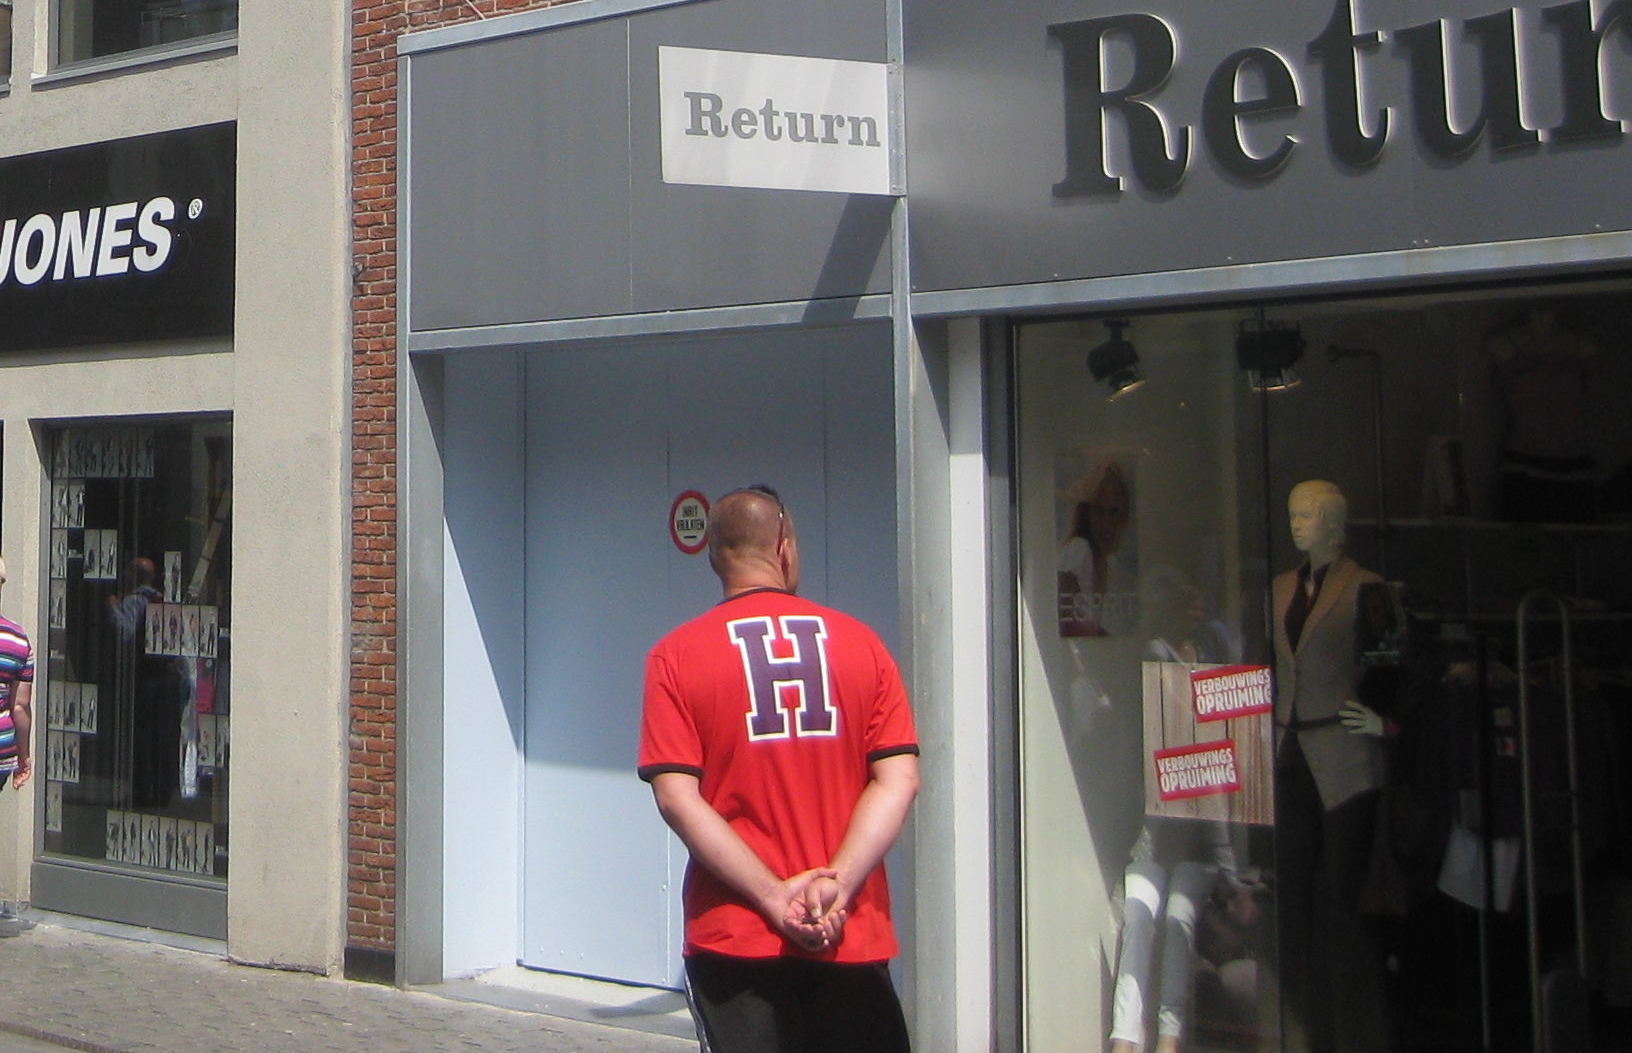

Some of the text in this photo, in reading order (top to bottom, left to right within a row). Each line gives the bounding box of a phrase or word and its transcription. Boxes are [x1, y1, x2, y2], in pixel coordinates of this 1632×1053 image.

[683, 91, 881, 147] Return
[726, 616, 837, 742] H
[1194, 668, 1271, 695] VERBOUWINGS
[1196, 685, 1272, 715] OPRUIMING
[1157, 748, 1233, 773] VERBOUWINGS
[1160, 764, 1236, 793] OPRUIMING
